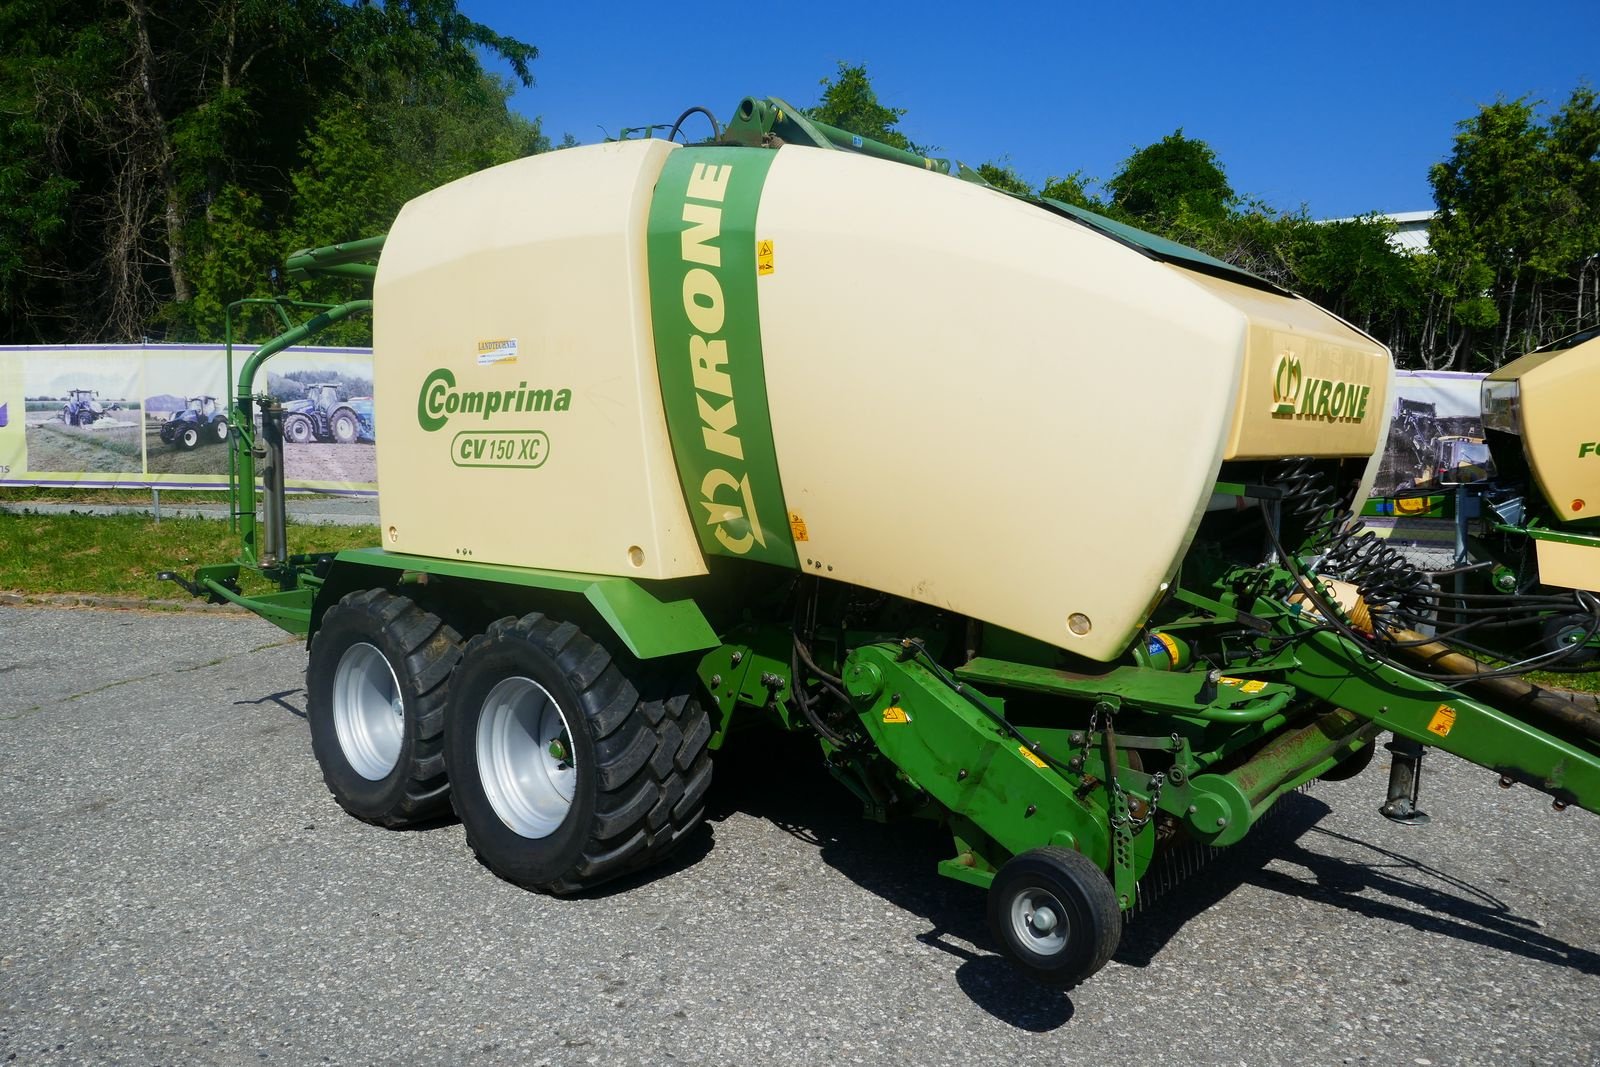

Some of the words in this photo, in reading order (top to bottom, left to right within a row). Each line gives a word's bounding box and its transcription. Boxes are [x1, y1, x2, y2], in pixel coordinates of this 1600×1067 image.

[681, 163, 744, 460] KRONE
[1300, 378, 1370, 419] KRONE
[460, 439, 487, 459] CV
[489, 439, 515, 460] 150
[517, 439, 540, 460] XC
